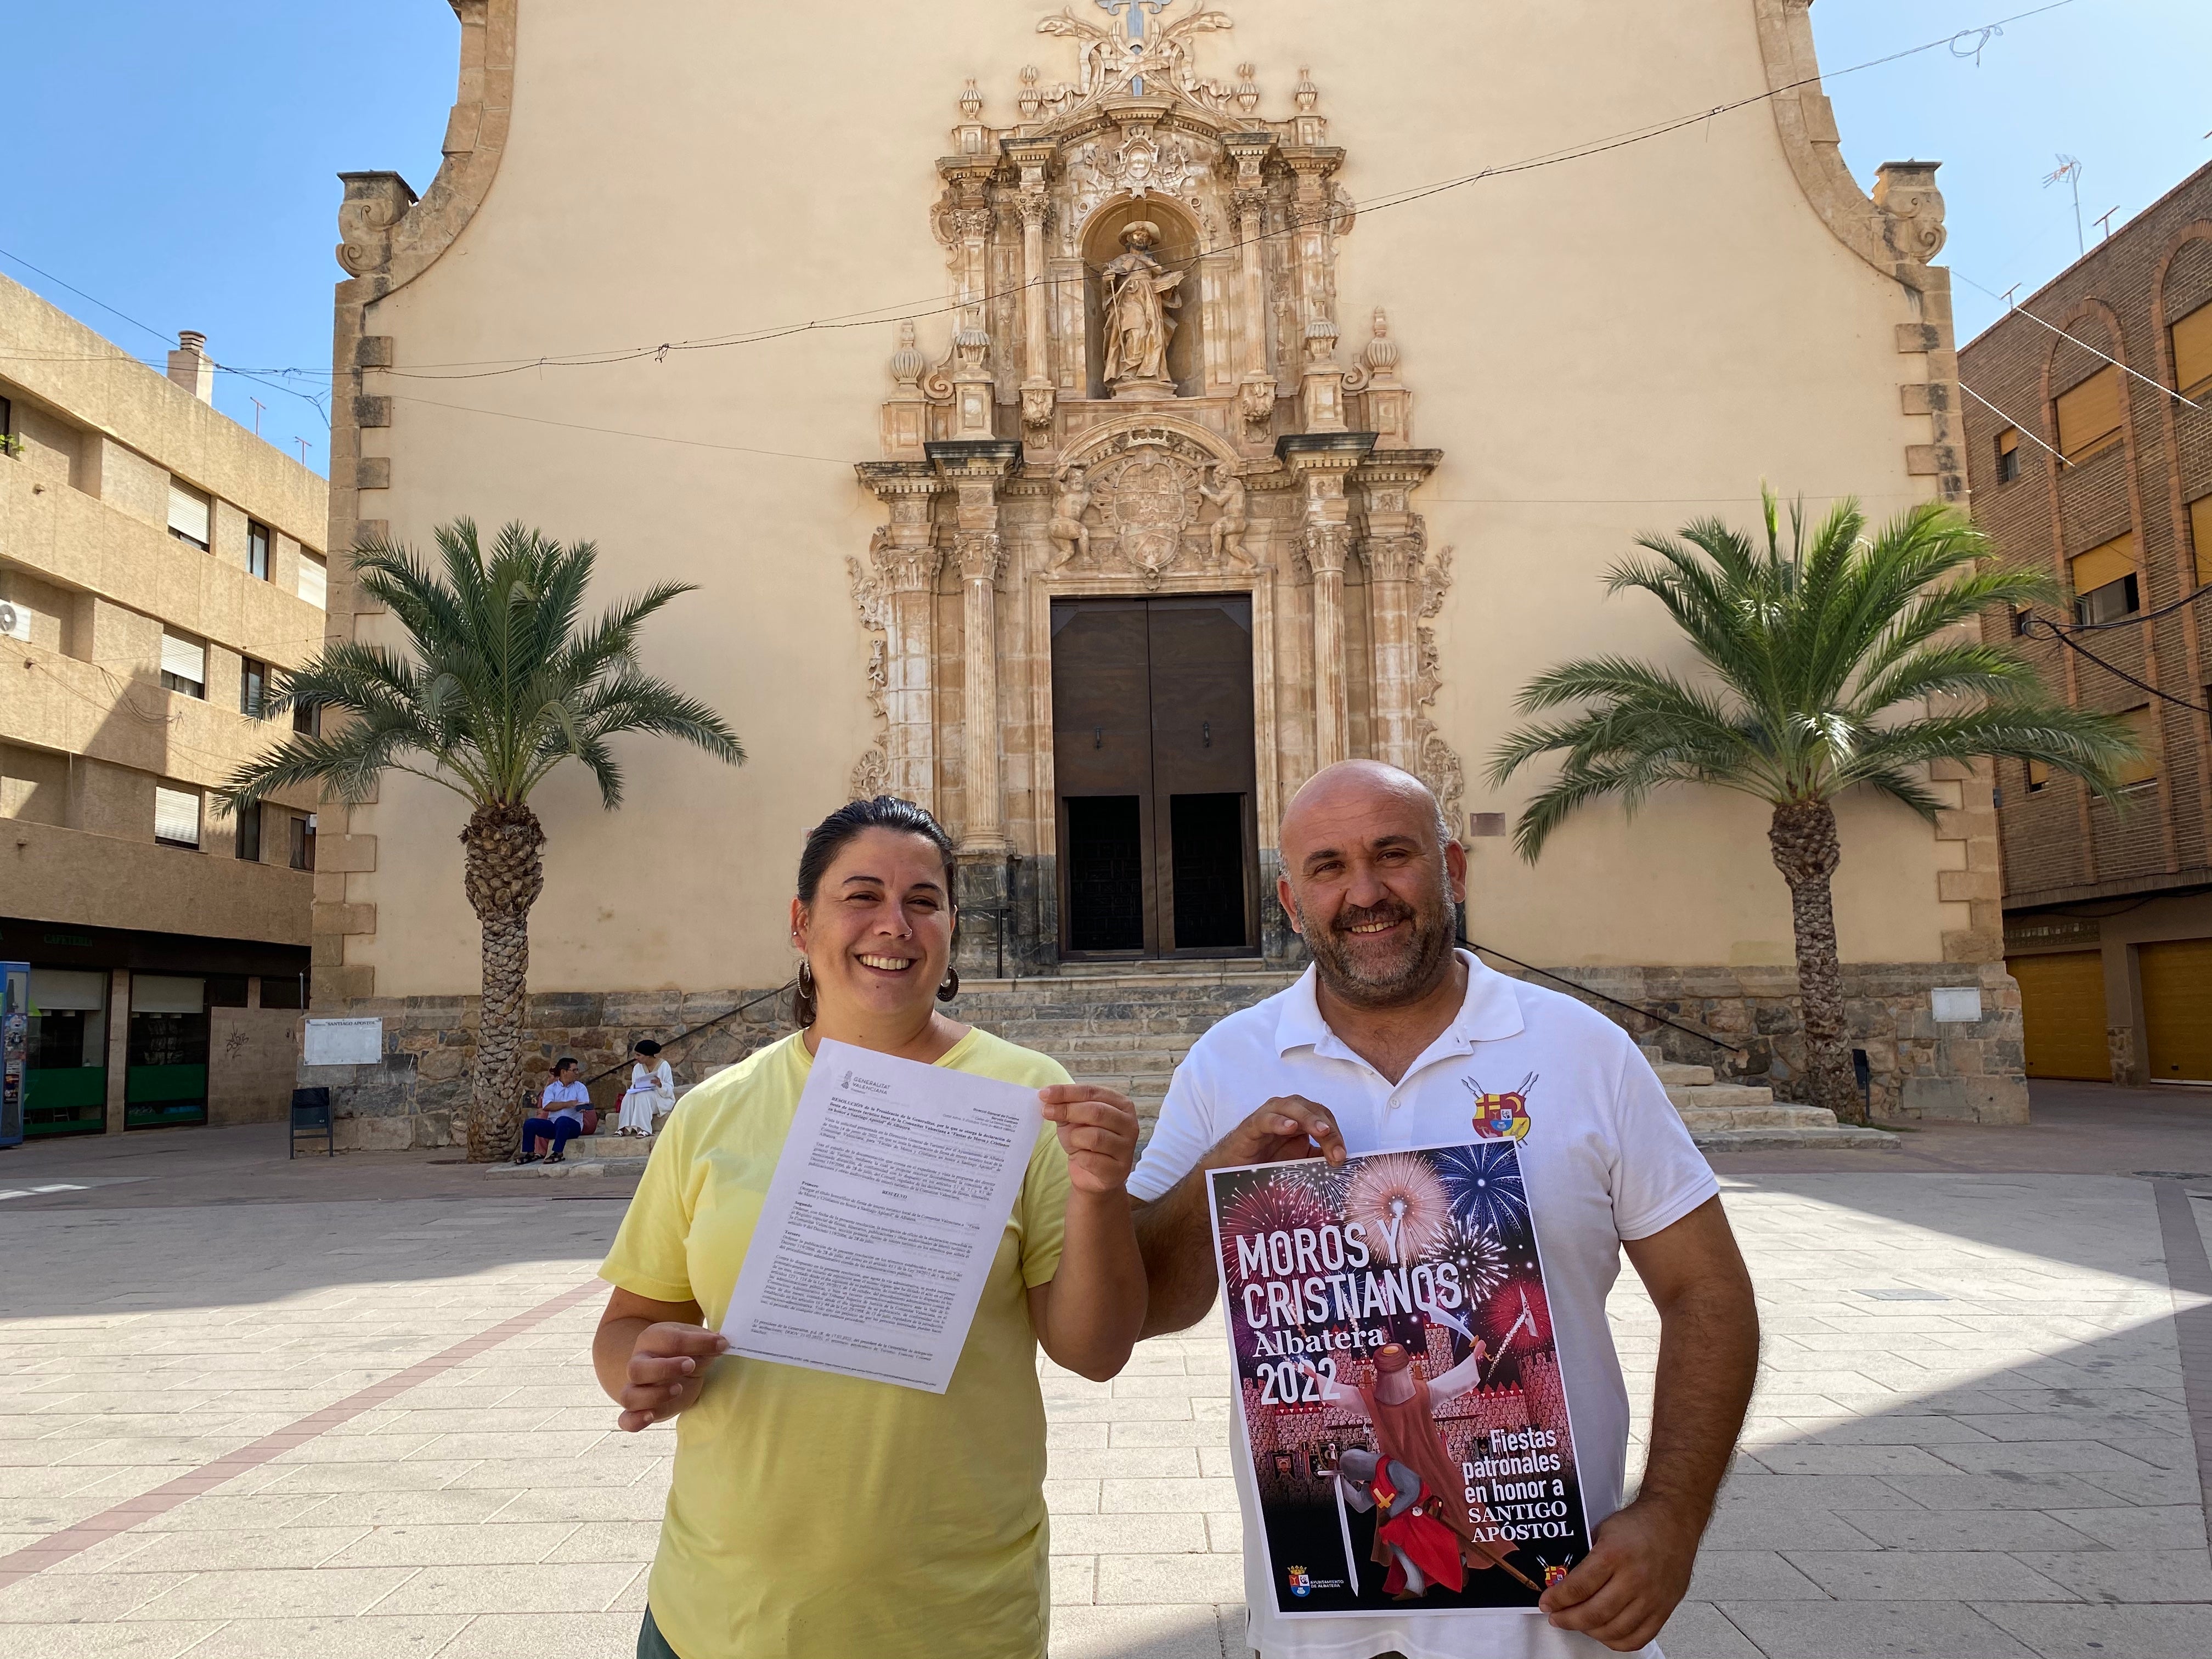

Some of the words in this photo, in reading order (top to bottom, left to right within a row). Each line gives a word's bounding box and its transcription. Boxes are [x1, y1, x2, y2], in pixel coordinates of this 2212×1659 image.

[853, 1082, 887, 1094] VALENCIANA
[854, 1076, 890, 1088] GENERALITAT
[1236, 1222, 1370, 1280] MOROS
[1376, 1217, 1401, 1264] Y
[1243, 1262, 1463, 1329] CRISTIANOS
[1252, 1328, 1386, 1358] Albatera
[1256, 1357, 1341, 1405] 2022
[1490, 1427, 1557, 1453] Fiestas
[1462, 1449, 1561, 1486] patronales
[1465, 1486, 1488, 1503] en
[1492, 1479, 1547, 1502] honor
[1552, 1479, 1564, 1496] a
[1468, 1500, 1567, 1523] SANTIGO
[1471, 1521, 1574, 1543] APÓSTOL
